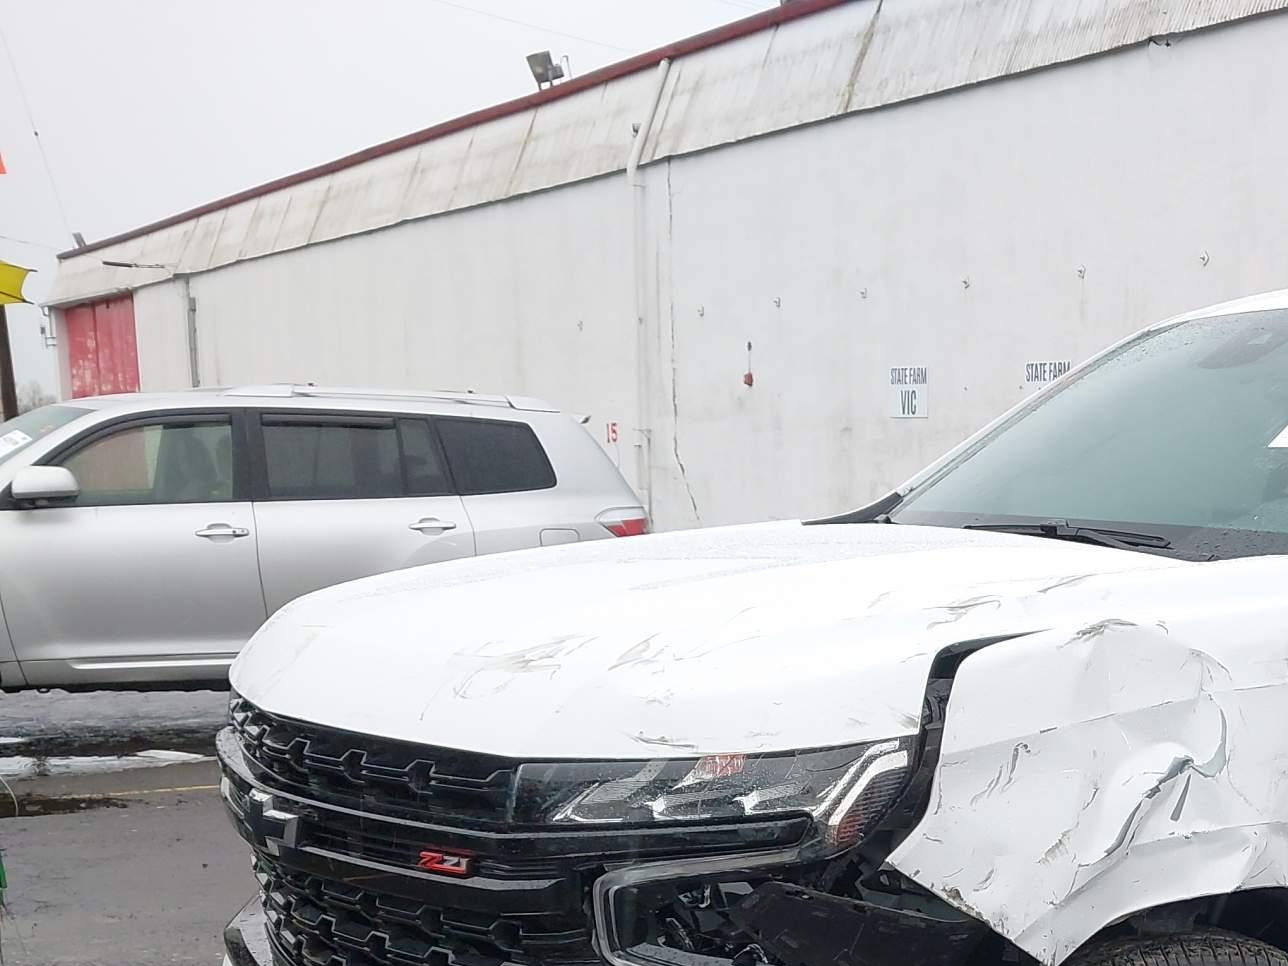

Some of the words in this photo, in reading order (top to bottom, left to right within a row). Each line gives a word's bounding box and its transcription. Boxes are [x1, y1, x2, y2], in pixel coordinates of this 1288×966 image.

[890, 367, 908, 385] STATE
[909, 367, 928, 385] FARM
[1025, 362, 1047, 382] STATE
[1048, 361, 1071, 381] FARM
[900, 389, 917, 416] VIC
[606, 422, 618, 443] 15
[416, 851, 470, 874] Z71
